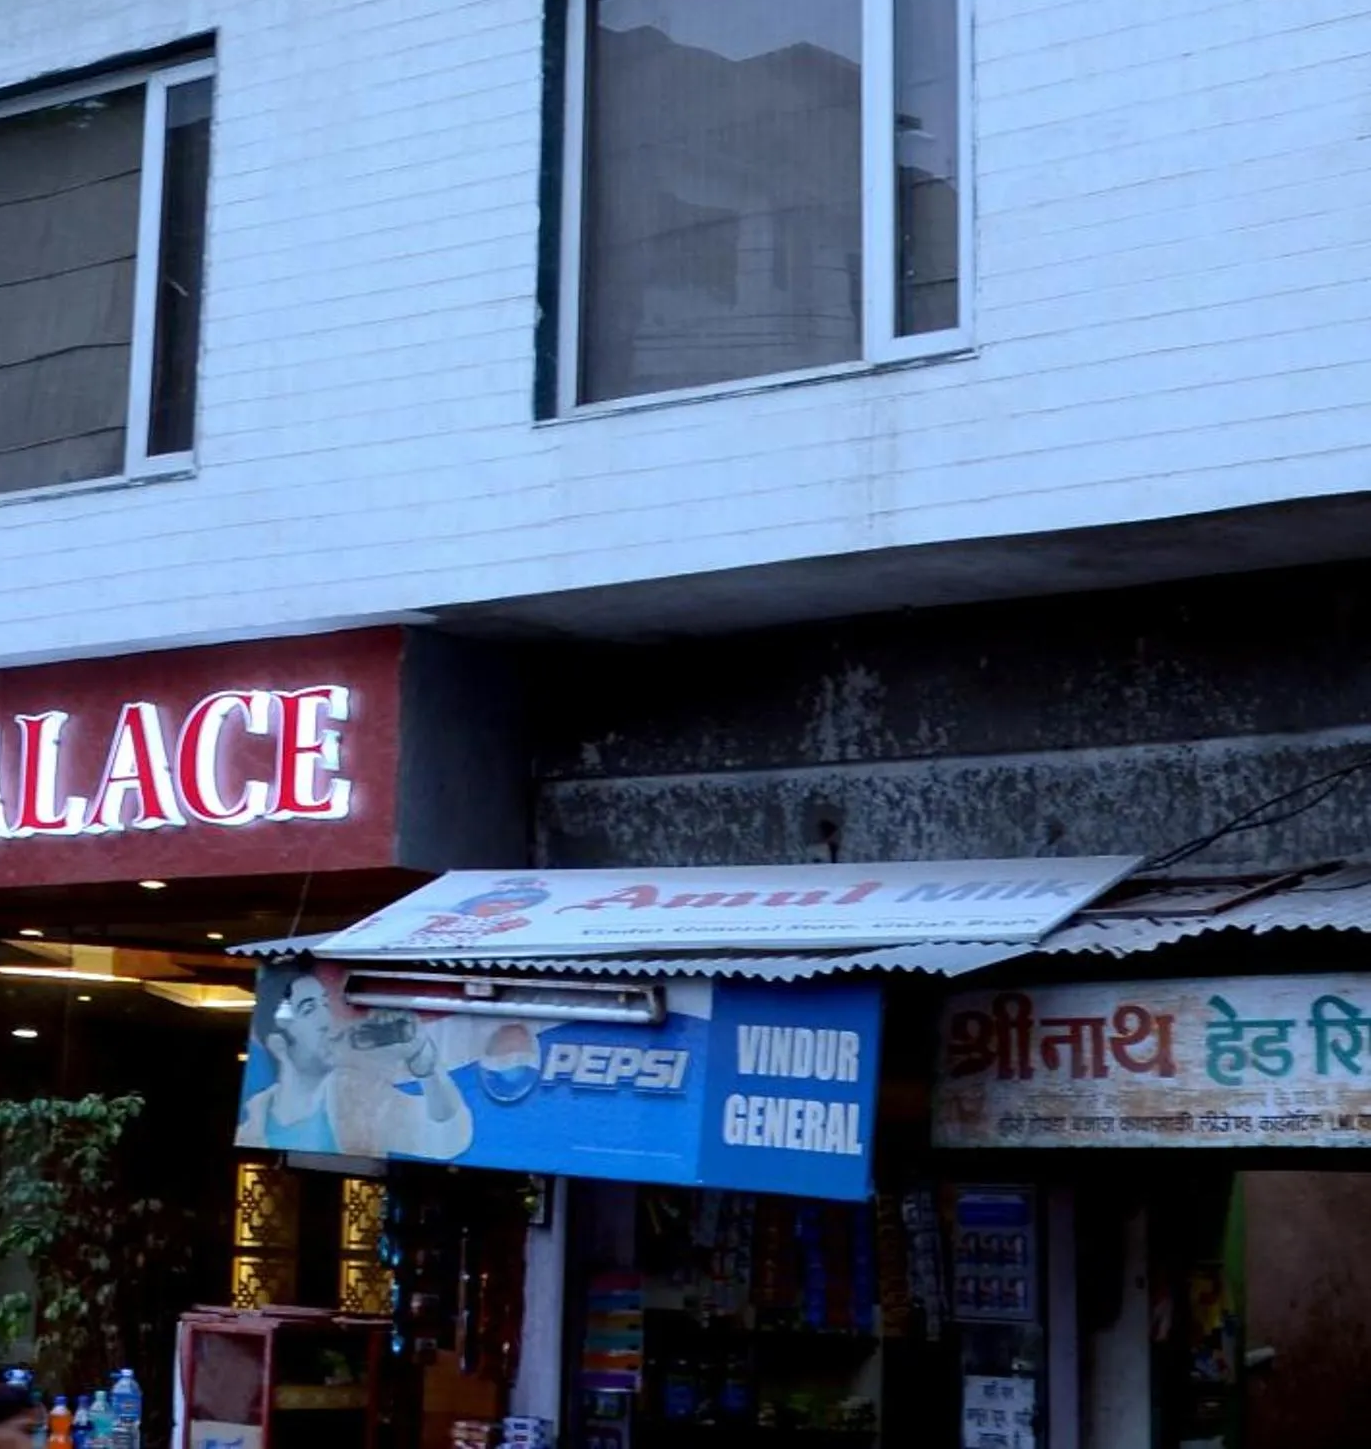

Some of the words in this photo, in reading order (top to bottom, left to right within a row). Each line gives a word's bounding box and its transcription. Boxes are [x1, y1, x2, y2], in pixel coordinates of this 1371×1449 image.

[554, 882, 882, 915] Amul
[894, 879, 1087, 903] Milk
[541, 1043, 689, 1094] PEPSI
[737, 1024, 859, 1083] VINDUR
[1205, 994, 1297, 1087] हेड
[723, 1093, 863, 1156] GENERAL
